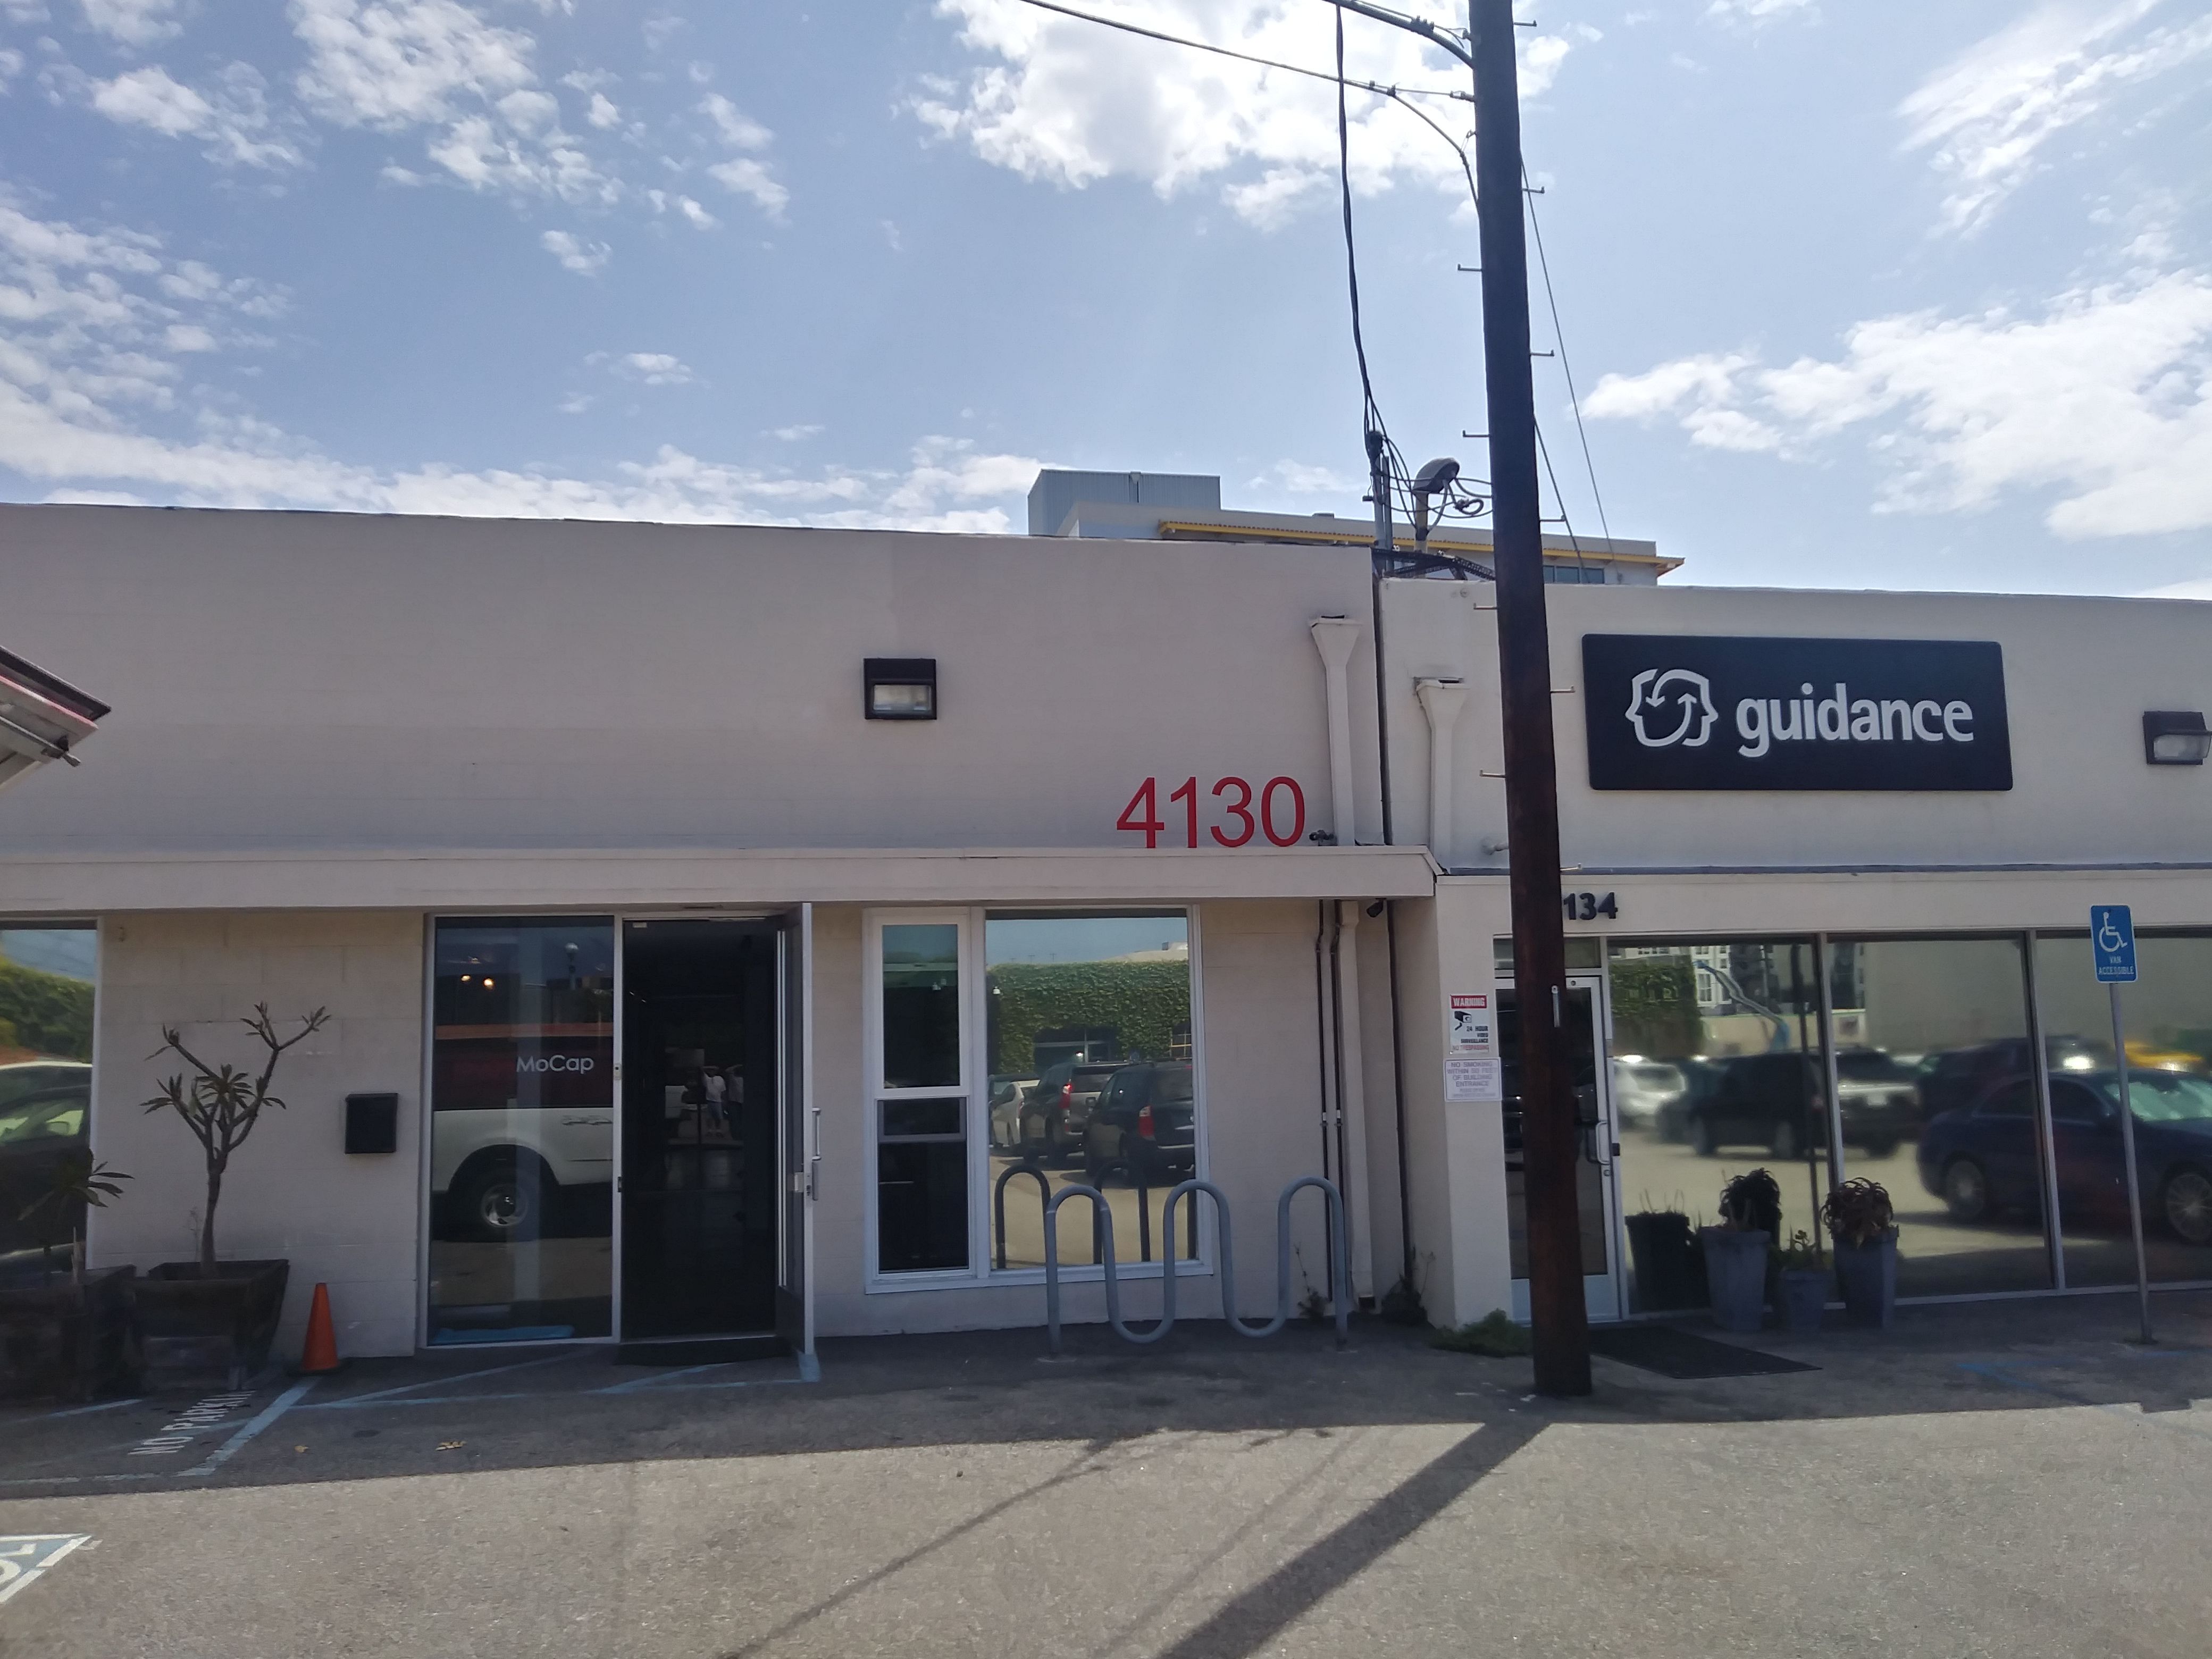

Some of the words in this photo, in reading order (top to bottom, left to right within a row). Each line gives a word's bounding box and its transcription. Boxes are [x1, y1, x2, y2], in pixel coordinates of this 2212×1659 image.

[1736, 682, 1974, 758] guidance
[1117, 776, 1305, 848] 4130
[2110, 956, 2122, 964] VAN
[2098, 966, 2134, 975] ACCESSIBLE
[1453, 998, 1485, 1007] WARNING
[516, 1054, 594, 1074] MoCap
[128, 1436, 194, 1455] NO
